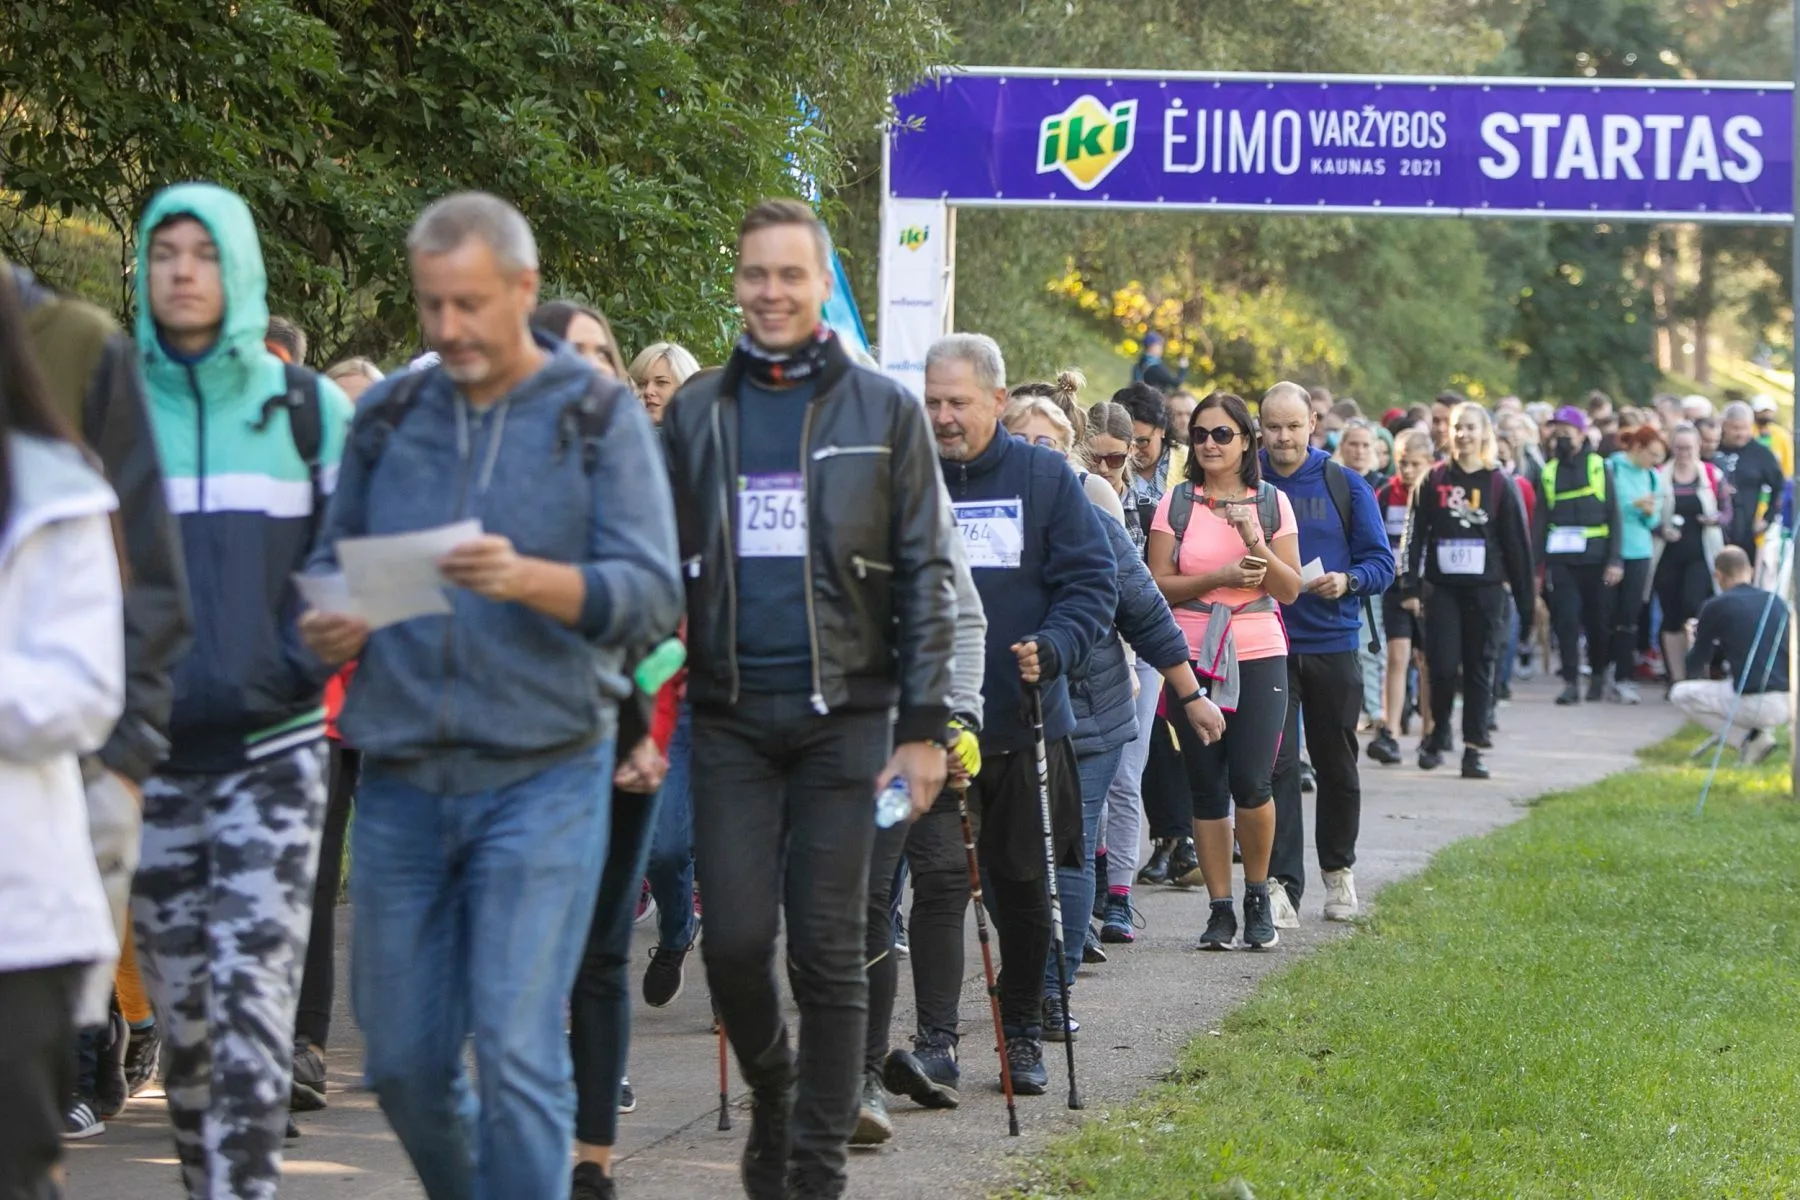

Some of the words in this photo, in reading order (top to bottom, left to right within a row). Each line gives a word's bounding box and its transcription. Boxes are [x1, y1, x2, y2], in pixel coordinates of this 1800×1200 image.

[1042, 105, 1131, 167] iki
[1163, 97, 1301, 175] ĖJIMO
[1308, 104, 1447, 149] VARŽYBOS
[1310, 157, 1386, 175] KAUNAS
[1399, 158, 1442, 176] 2021
[1478, 111, 1764, 183] STARTAS
[898, 225, 931, 248] iki
